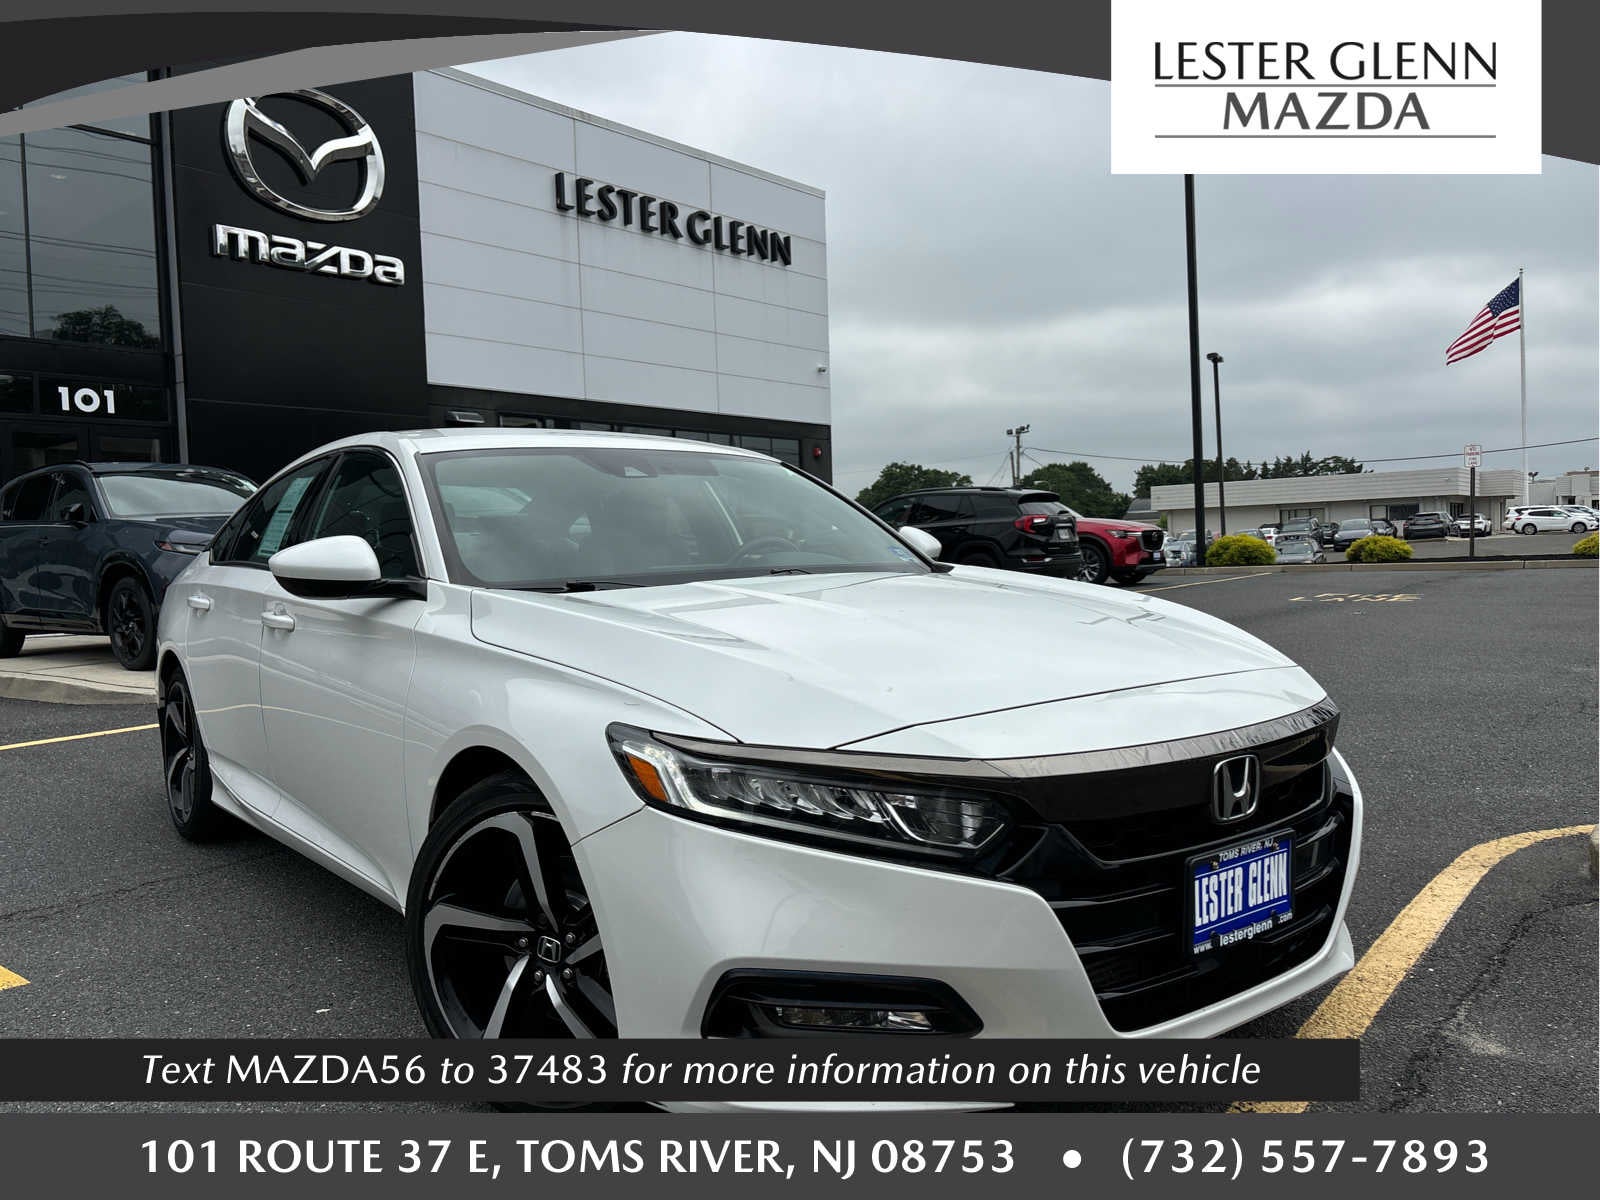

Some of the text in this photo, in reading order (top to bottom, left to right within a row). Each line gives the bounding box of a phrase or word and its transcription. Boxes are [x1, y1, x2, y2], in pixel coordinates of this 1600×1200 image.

[555, 172, 792, 266] LESTER GLENN
[211, 224, 405, 285] mazda
[58, 386, 115, 414] 101
[1219, 848, 1239, 862] TOMS
[1264, 838, 1274, 849] NJ
[1194, 852, 1288, 927] LESTER GLENN
[1219, 919, 1273, 947] lesterglenn
